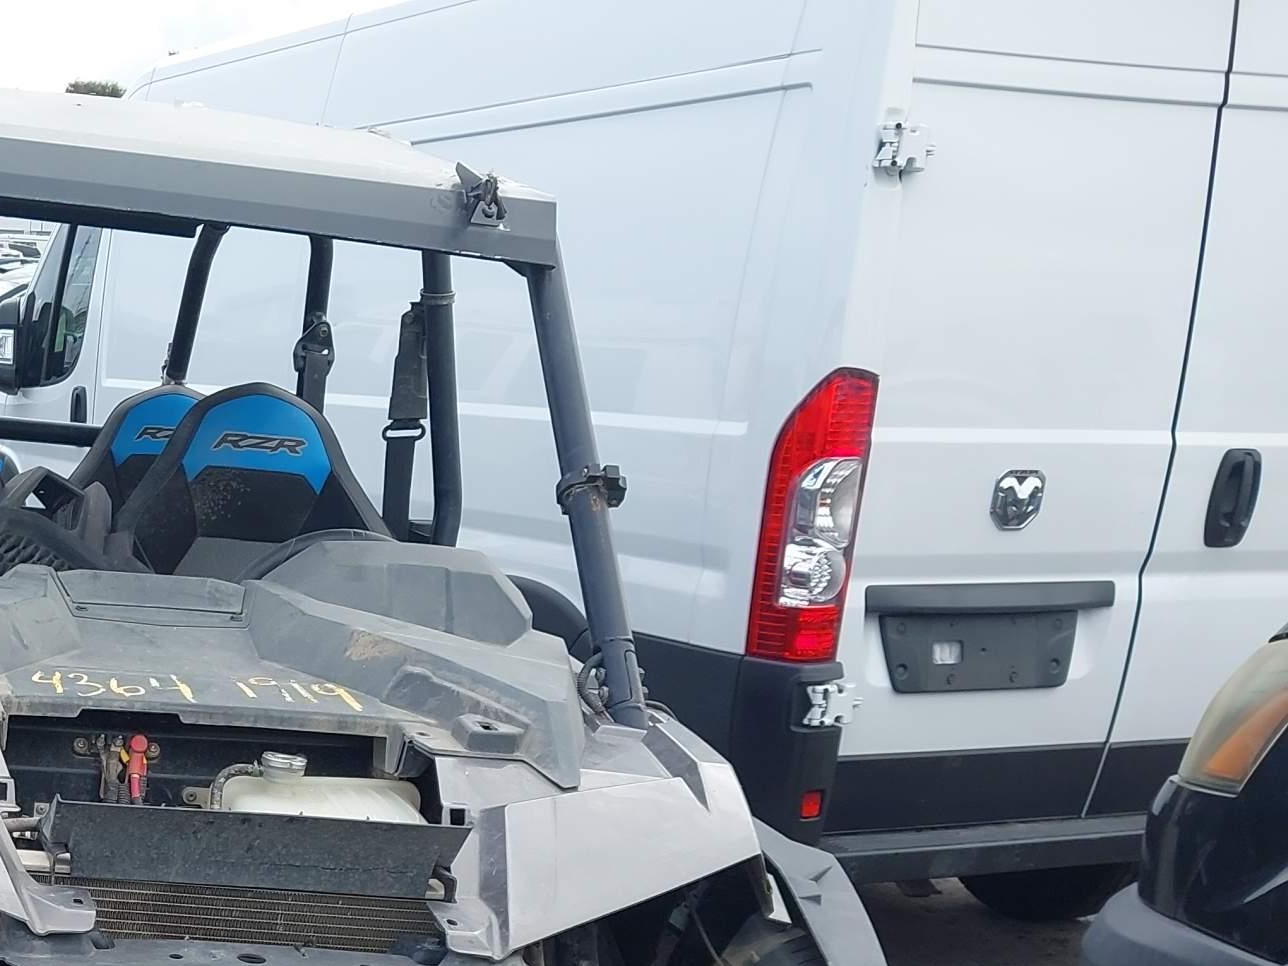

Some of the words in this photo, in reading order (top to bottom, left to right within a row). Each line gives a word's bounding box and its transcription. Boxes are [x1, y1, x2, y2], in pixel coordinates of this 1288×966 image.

[135, 425, 177, 441] RZ
[212, 430, 309, 457] RZR
[31, 671, 198, 703] 4364
